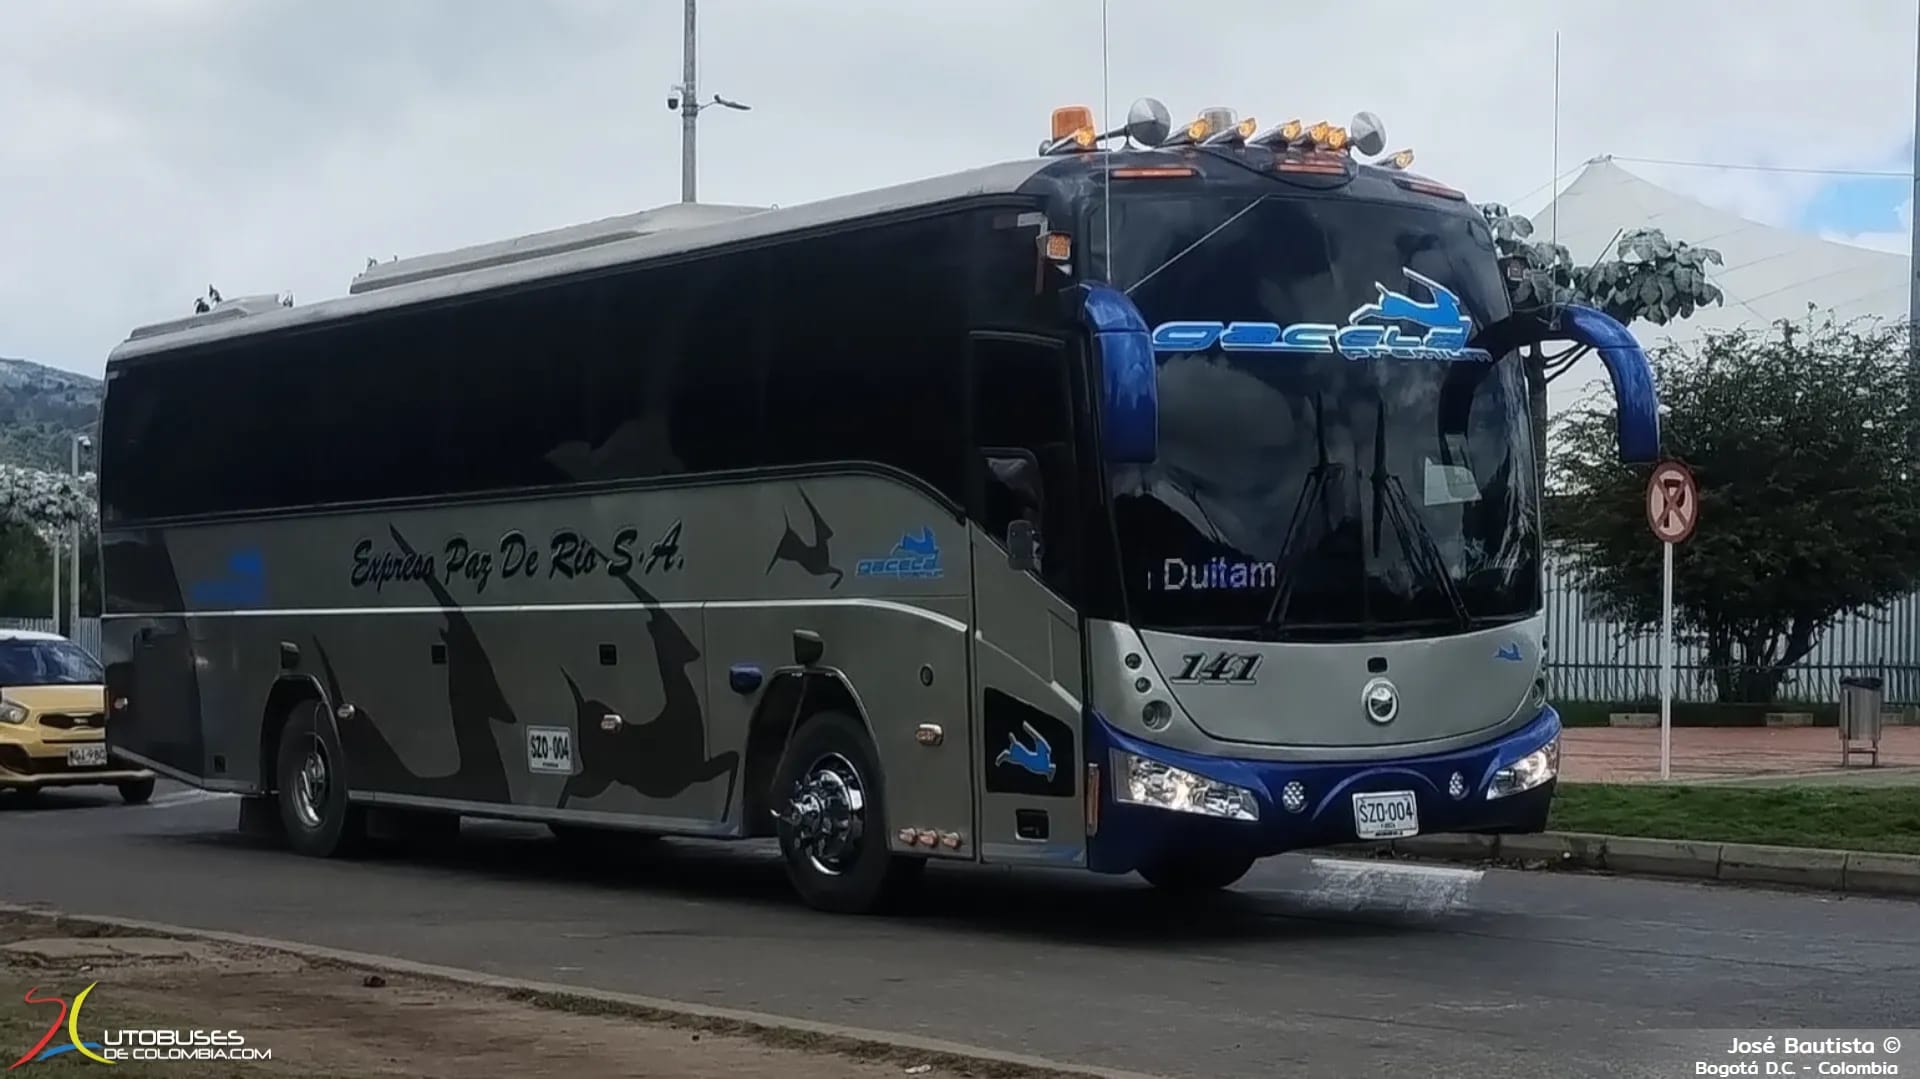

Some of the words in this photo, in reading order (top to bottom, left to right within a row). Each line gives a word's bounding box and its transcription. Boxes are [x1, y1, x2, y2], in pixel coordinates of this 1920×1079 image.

[351, 538, 435, 593] Expreso
[444, 535, 494, 595] Paz
[500, 530, 538, 575] De
[1164, 557, 1276, 590] Duitam
[1169, 652, 1264, 685] 141
